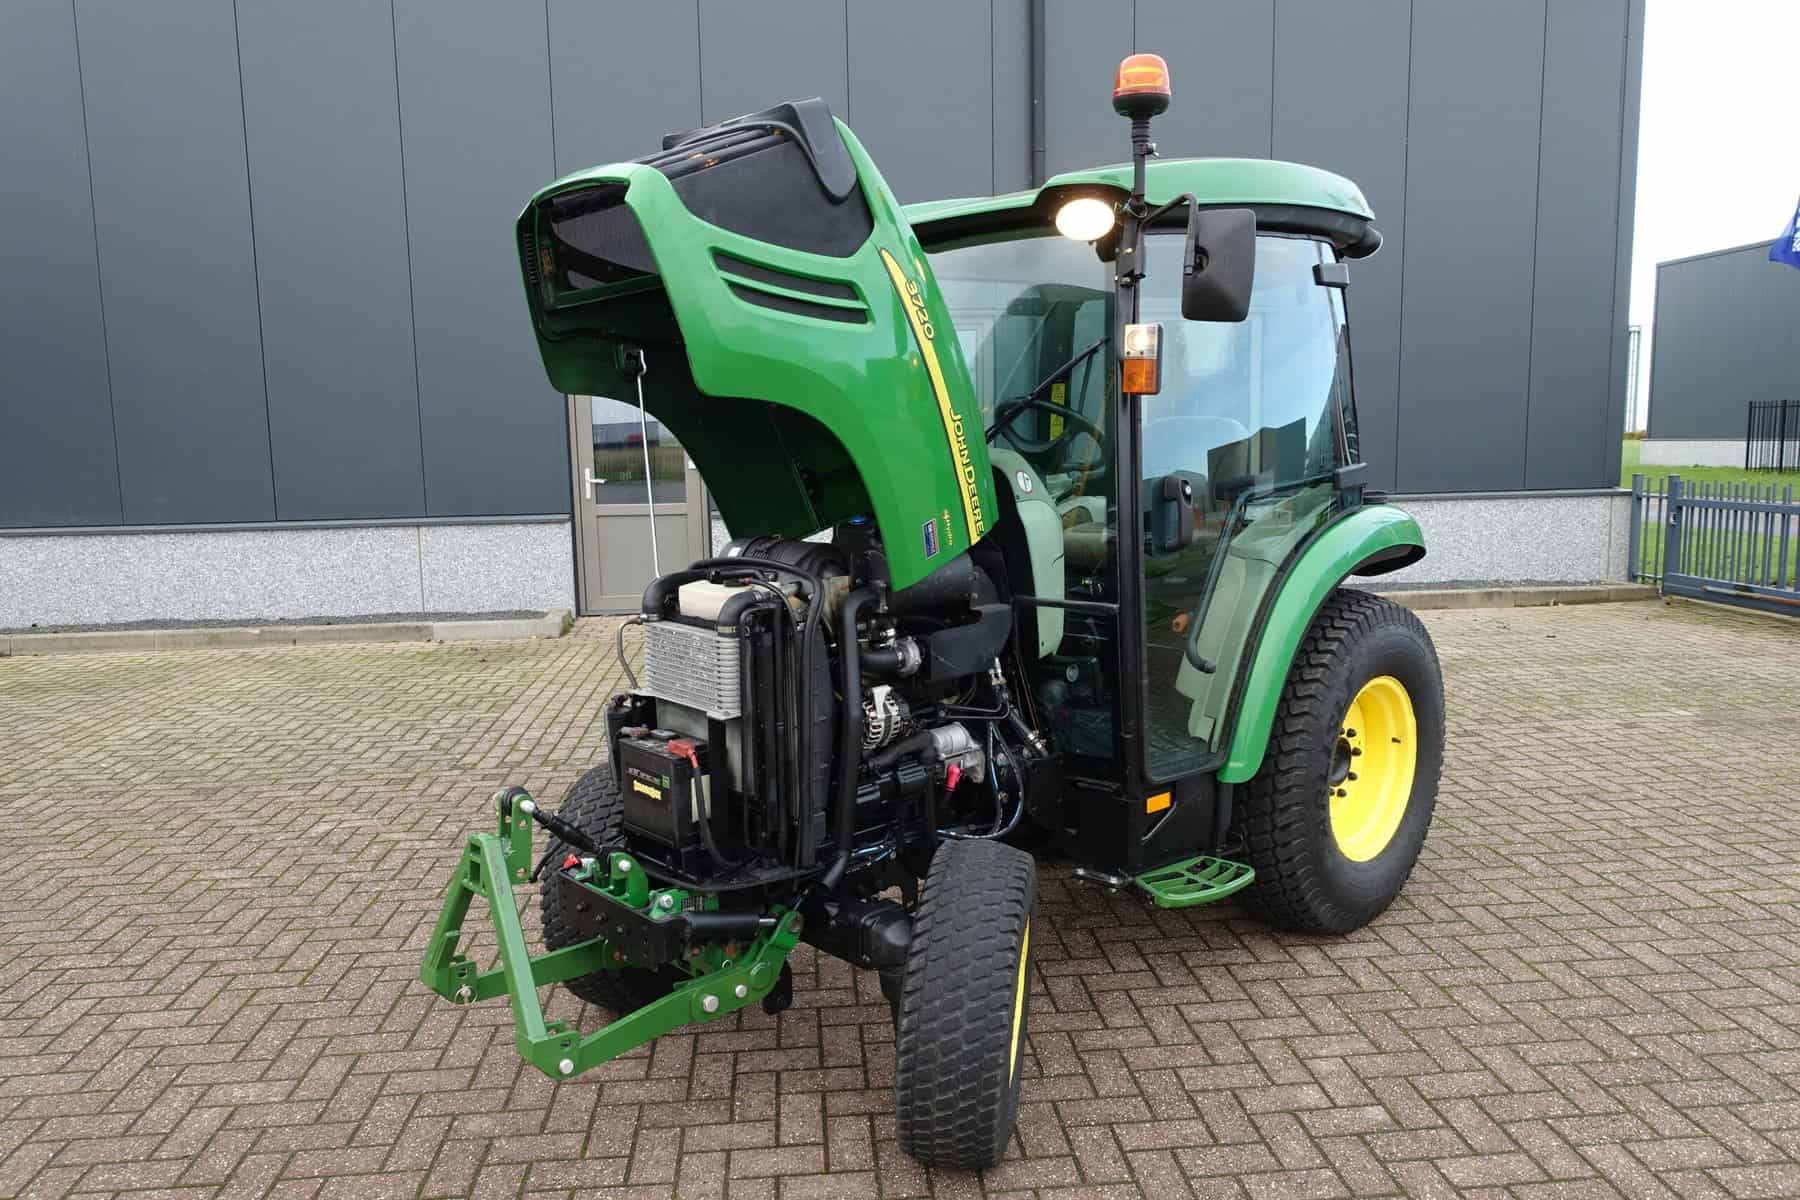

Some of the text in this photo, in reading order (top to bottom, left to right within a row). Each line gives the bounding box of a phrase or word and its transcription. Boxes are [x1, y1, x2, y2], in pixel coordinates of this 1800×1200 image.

[905, 280, 934, 341] 3720
[950, 407, 985, 536] JOHN DEERE
